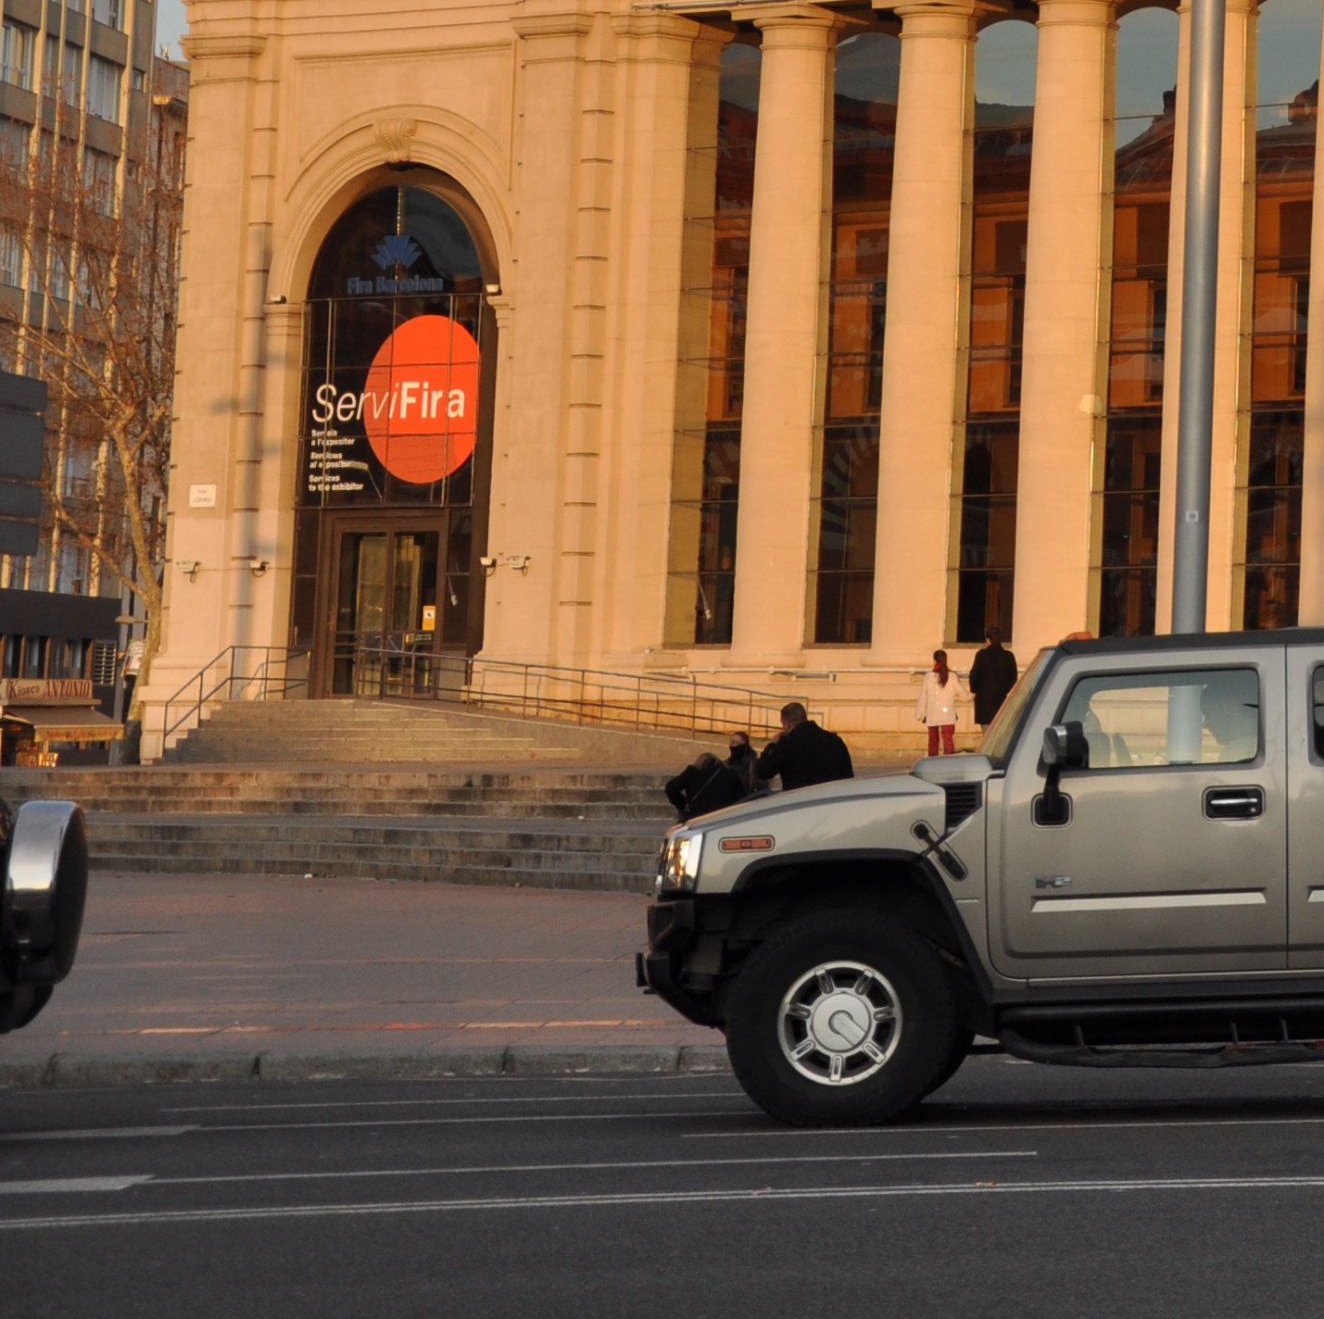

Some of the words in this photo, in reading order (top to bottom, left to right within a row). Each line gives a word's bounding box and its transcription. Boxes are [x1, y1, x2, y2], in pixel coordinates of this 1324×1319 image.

[347, 277, 373, 295] Fira
[375, 274, 443, 294] Barcelona
[312, 381, 465, 423] ServiFira
[43, 679, 91, 698] ANTONIO
